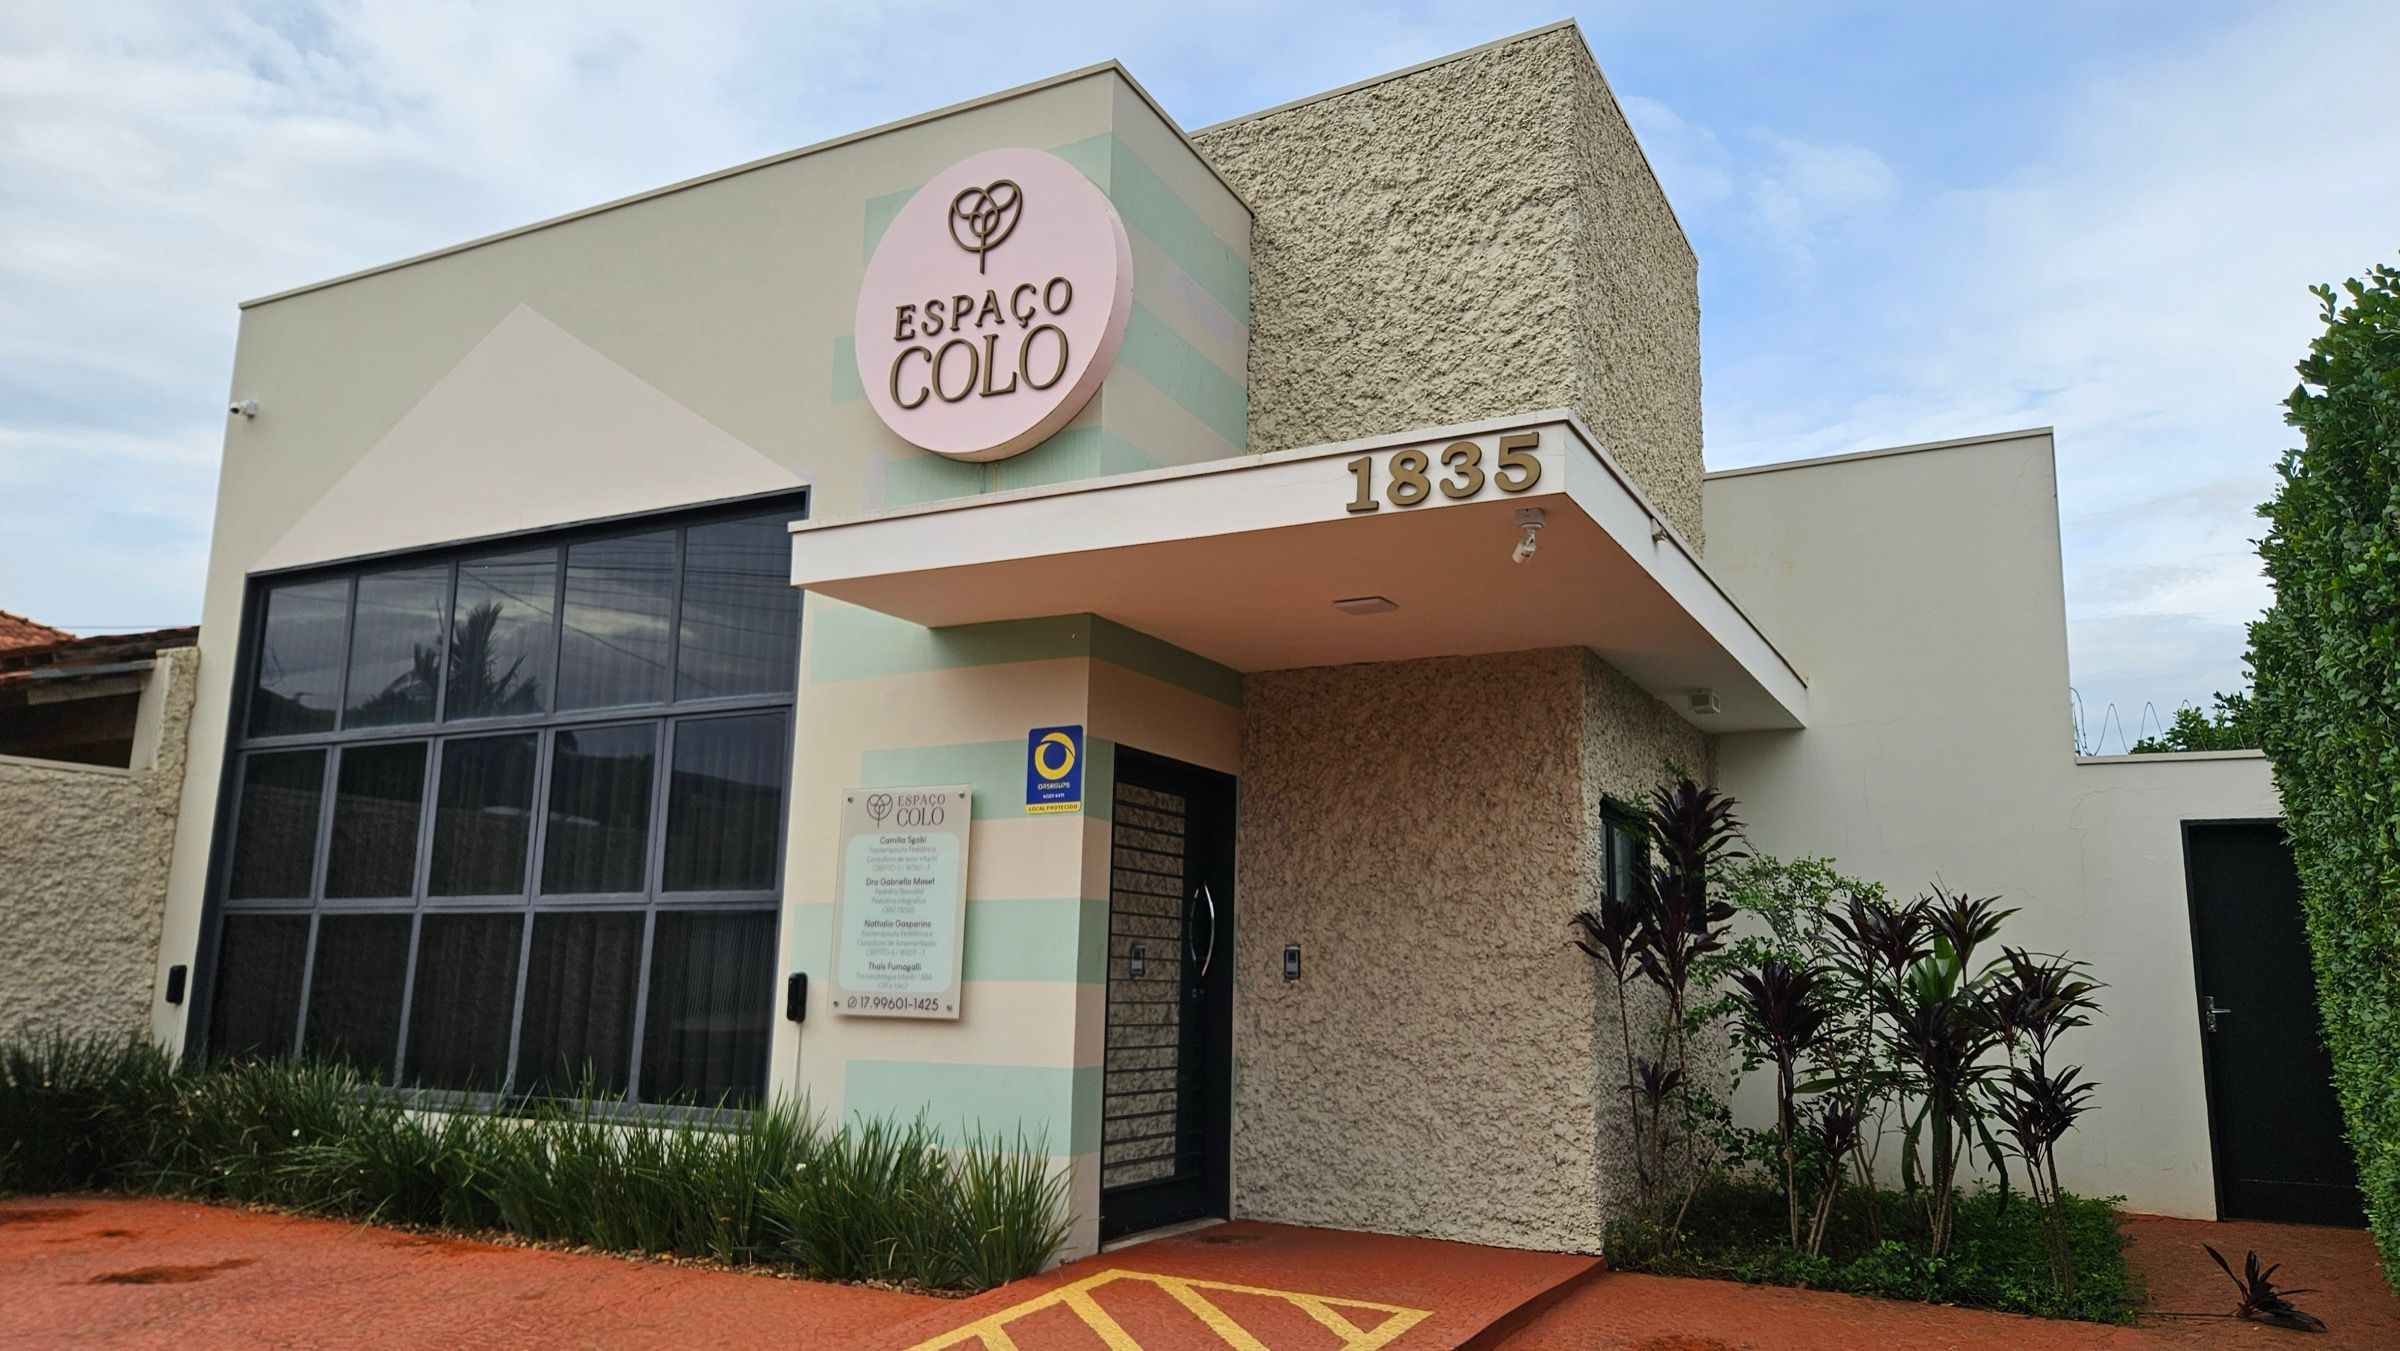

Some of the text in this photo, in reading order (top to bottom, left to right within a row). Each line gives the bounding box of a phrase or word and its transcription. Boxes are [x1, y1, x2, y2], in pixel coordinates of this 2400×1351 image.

[893, 276, 1073, 341] ESPAÇO
[889, 323, 1071, 409] COLO
[1346, 431, 1542, 512] 1835
[898, 793, 946, 807] ESPAÇO
[1046, 803, 1078, 811] PROTECIDO
[896, 806, 945, 827] COLO
[895, 919, 932, 929] Gasparino
[860, 996, 940, 1011] 17.99601-1425
